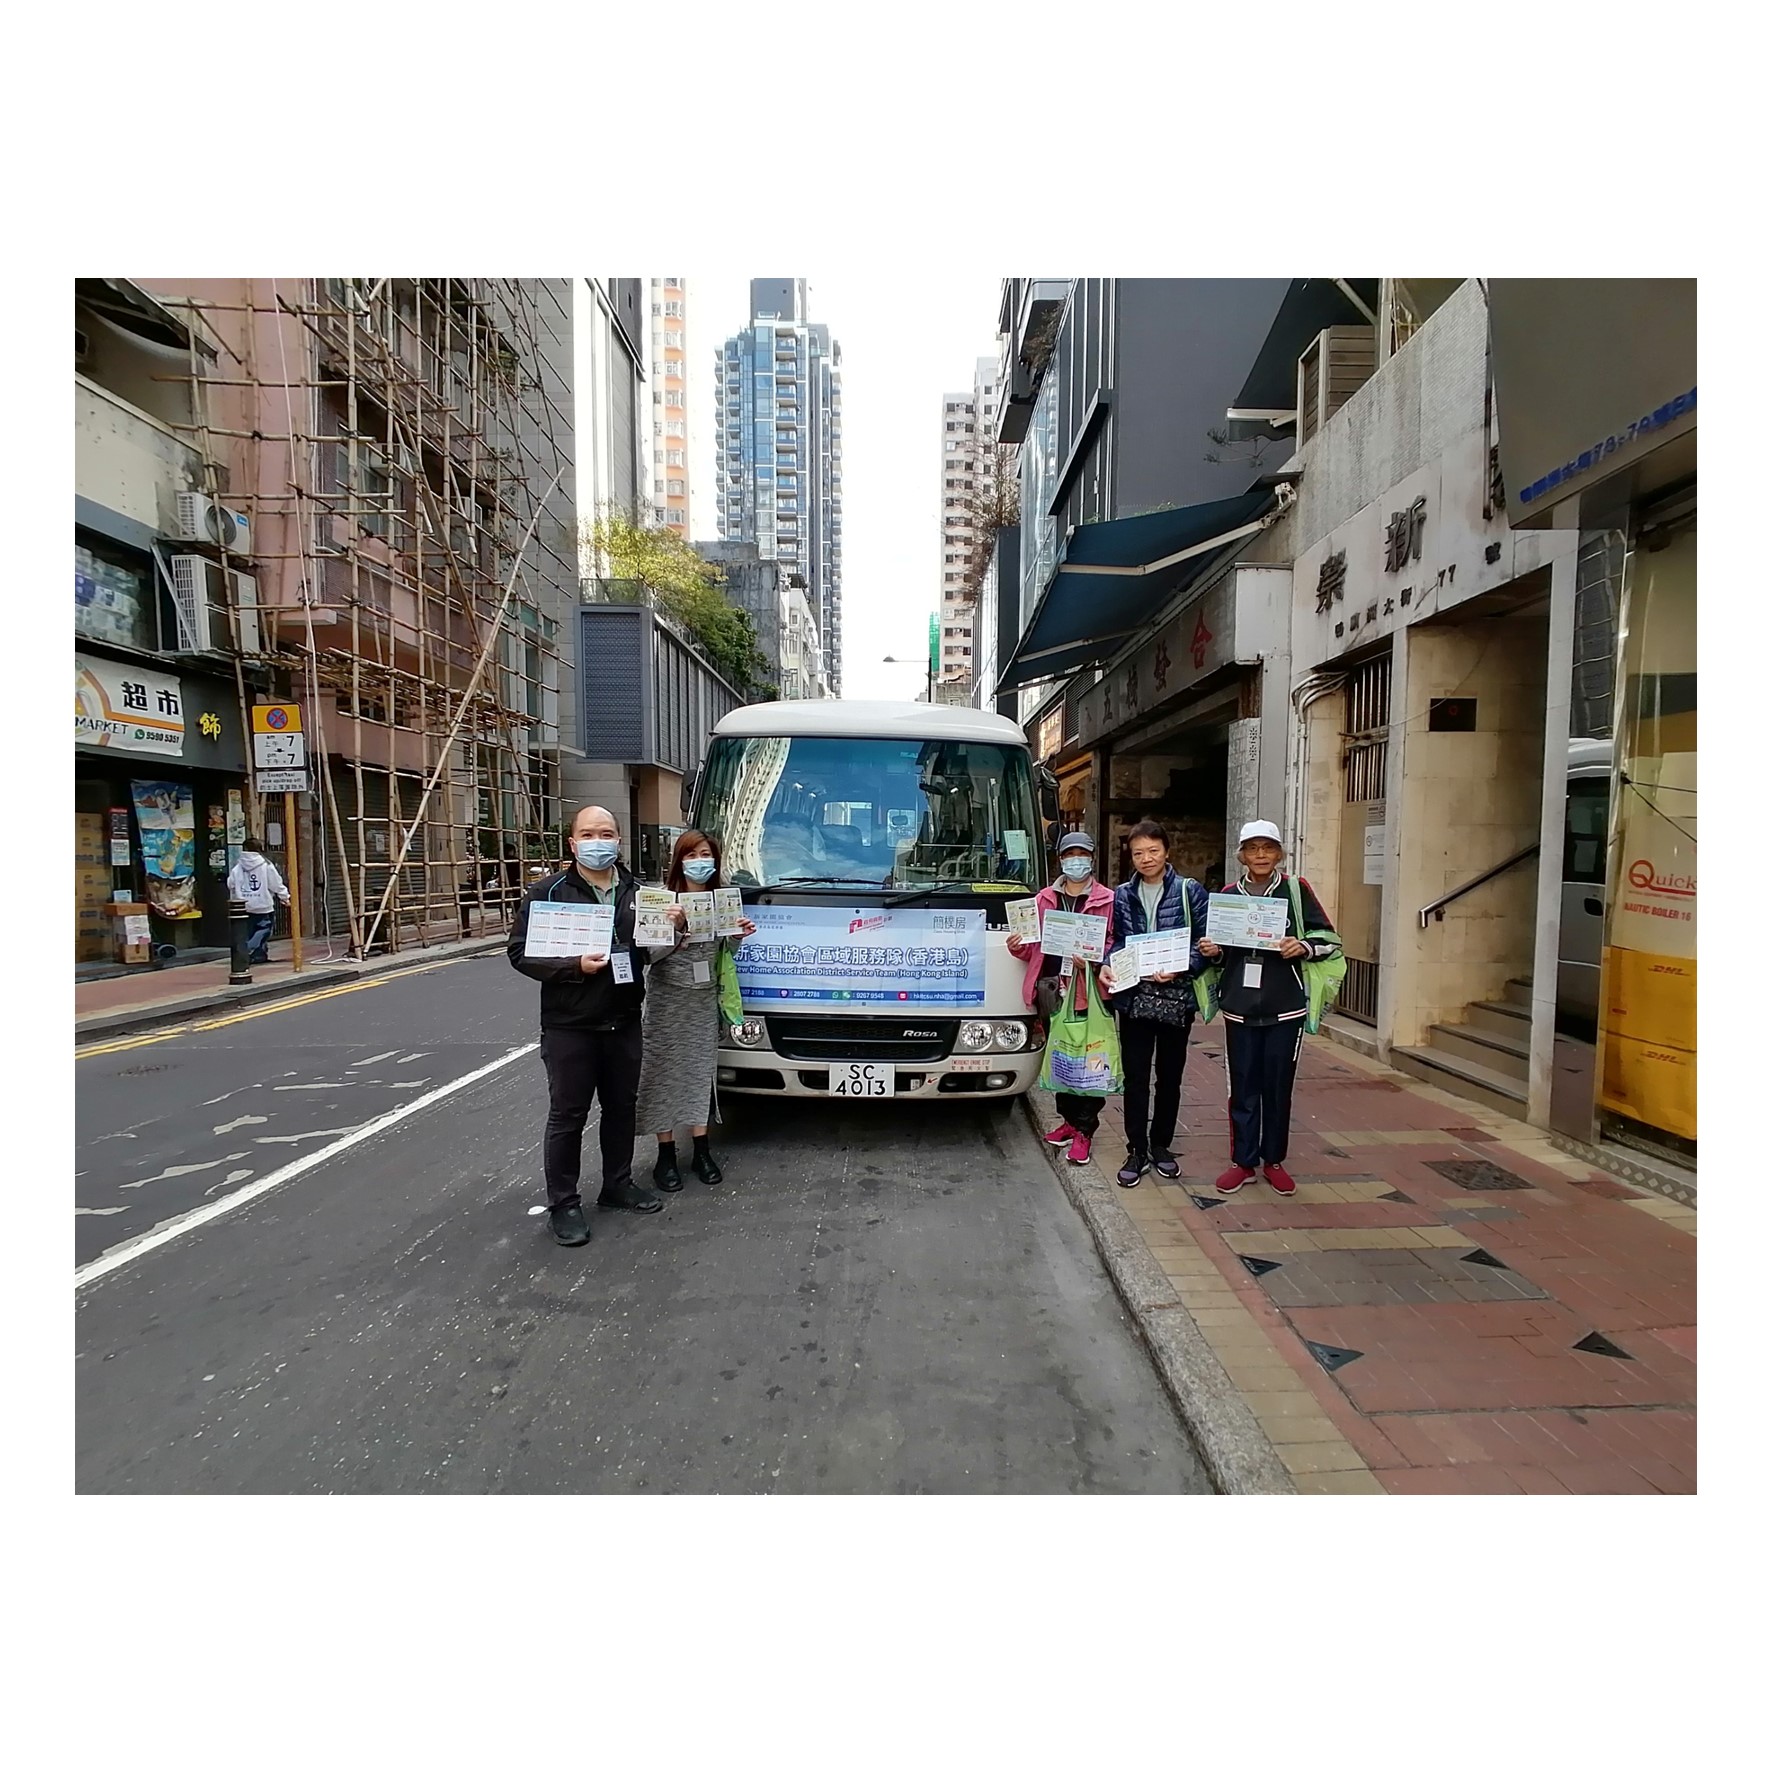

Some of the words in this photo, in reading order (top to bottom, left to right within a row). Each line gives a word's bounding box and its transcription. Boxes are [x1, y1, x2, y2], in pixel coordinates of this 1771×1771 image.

[121, 681, 179, 716] 超市
[75, 717, 129, 735] MARKET
[200, 712, 221, 742] 飾
[286, 735, 295, 747] 7
[287, 753, 296, 765] 7
[1629, 859, 1697, 896] Quick
[750, 966, 772, 975] Home
[773, 966, 816, 976] Association
[817, 967, 845, 977] District
[846, 968, 874, 977] Service
[875, 968, 896, 977] Team
[898, 968, 920, 979] (Hong
[921, 969, 941, 979] Kong
[942, 969, 968, 979] Island)
[1650, 964, 1688, 976] DHL
[848, 1065, 875, 1080] SC
[835, 1080, 886, 1096] 4013
